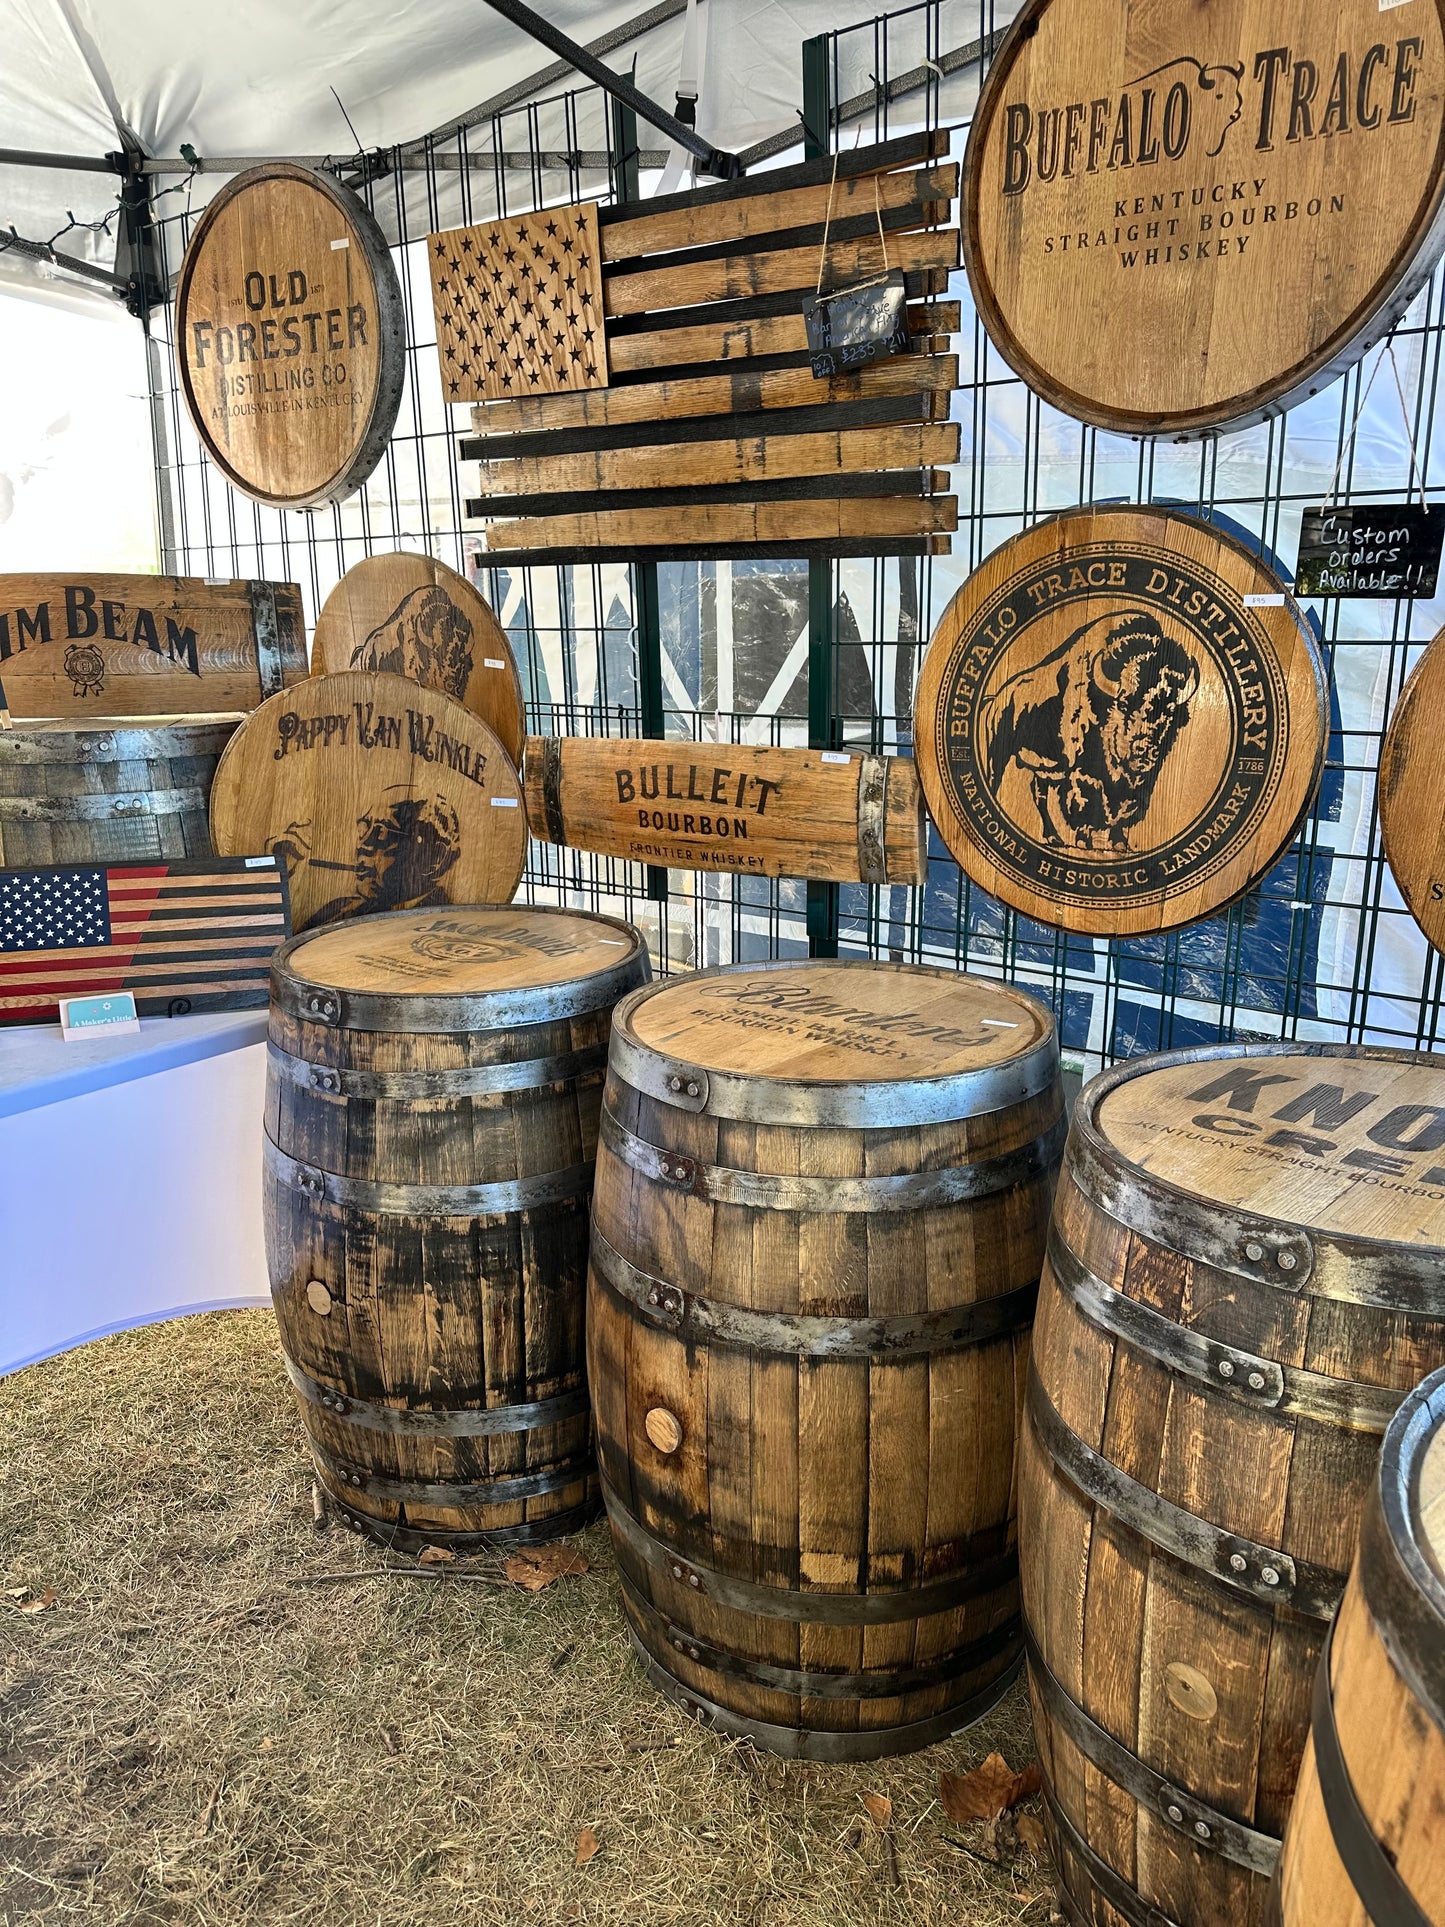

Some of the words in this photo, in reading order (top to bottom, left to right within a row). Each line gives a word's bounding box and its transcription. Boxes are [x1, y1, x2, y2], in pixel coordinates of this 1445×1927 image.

[1002, 81, 1193, 197] BUFFALO
[1254, 37, 1424, 153] TRACE
[1113, 178, 1267, 219] KENTUCKY
[1044, 219, 1180, 254] STRAIGHT
[1199, 194, 1346, 232] BOURBON
[1120, 236, 1251, 269] WHISKEY
[245, 271, 308, 312] OLD
[192, 302, 369, 369] FORESTER
[220, 367, 315, 399] DISTILLING
[322, 363, 352, 386] CO.
[229, 401, 288, 416] LOUISVILLE
[292, 400, 303, 411] IN
[306, 392, 365, 409] KENTUCKY
[1321, 516, 1410, 545] Custom
[63, 585, 202, 679] BEAM
[951, 607, 1017, 737] BUFFALO
[1027, 562, 1127, 606] TRACE
[1145, 569, 1268, 750] DISTILLERY
[274, 711, 351, 760] PAPPY
[353, 702, 401, 749] VAN
[406, 708, 487, 787] WINKLE
[1238, 760, 1264, 771] 1786
[615, 765, 780, 815] BULLEIT
[638, 809, 747, 838] BOURBON
[959, 772, 1028, 864] NATIONAL
[1038, 862, 1148, 889] HISTORIC
[1160, 783, 1251, 875] LANDMARK
[630, 842, 693, 859] FRONTIER
[701, 851, 765, 868] WHISKEY
[690, 1009, 801, 1035] BOURBON
[804, 1031, 916, 1060] WHISKEY
[724, 1007, 806, 1027] SINGLE
[806, 1023, 900, 1048] BARREL
[1135, 1120, 1239, 1148] KENTUCKY
[1244, 1145, 1345, 1176] STRAIGHT
